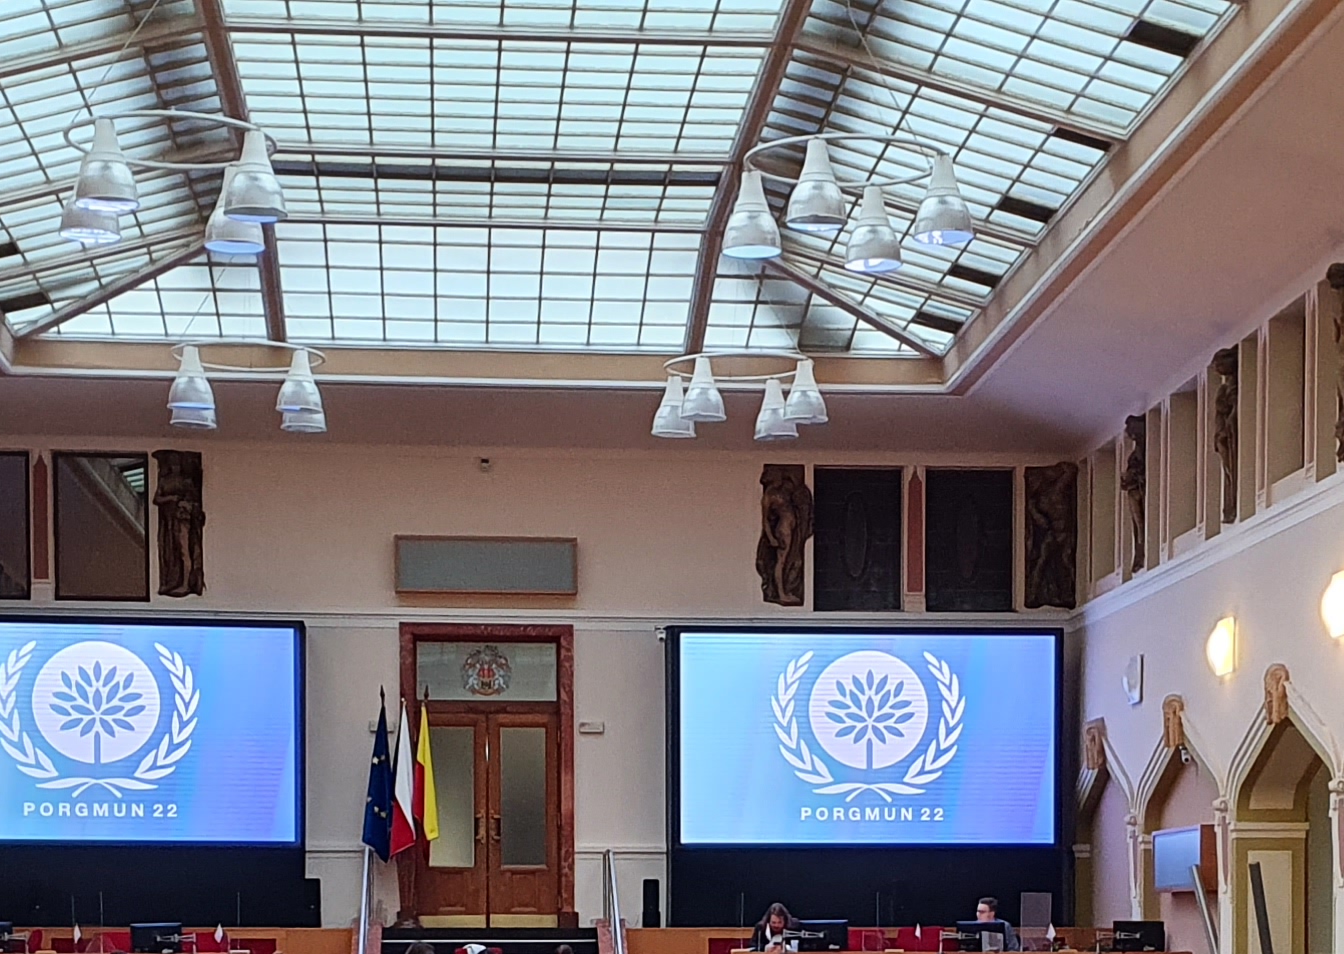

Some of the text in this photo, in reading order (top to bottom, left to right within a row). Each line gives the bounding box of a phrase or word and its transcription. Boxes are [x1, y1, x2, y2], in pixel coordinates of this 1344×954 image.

[23, 802, 178, 818] PORGMUN 22
[800, 807, 944, 821] PORGMUN 22
